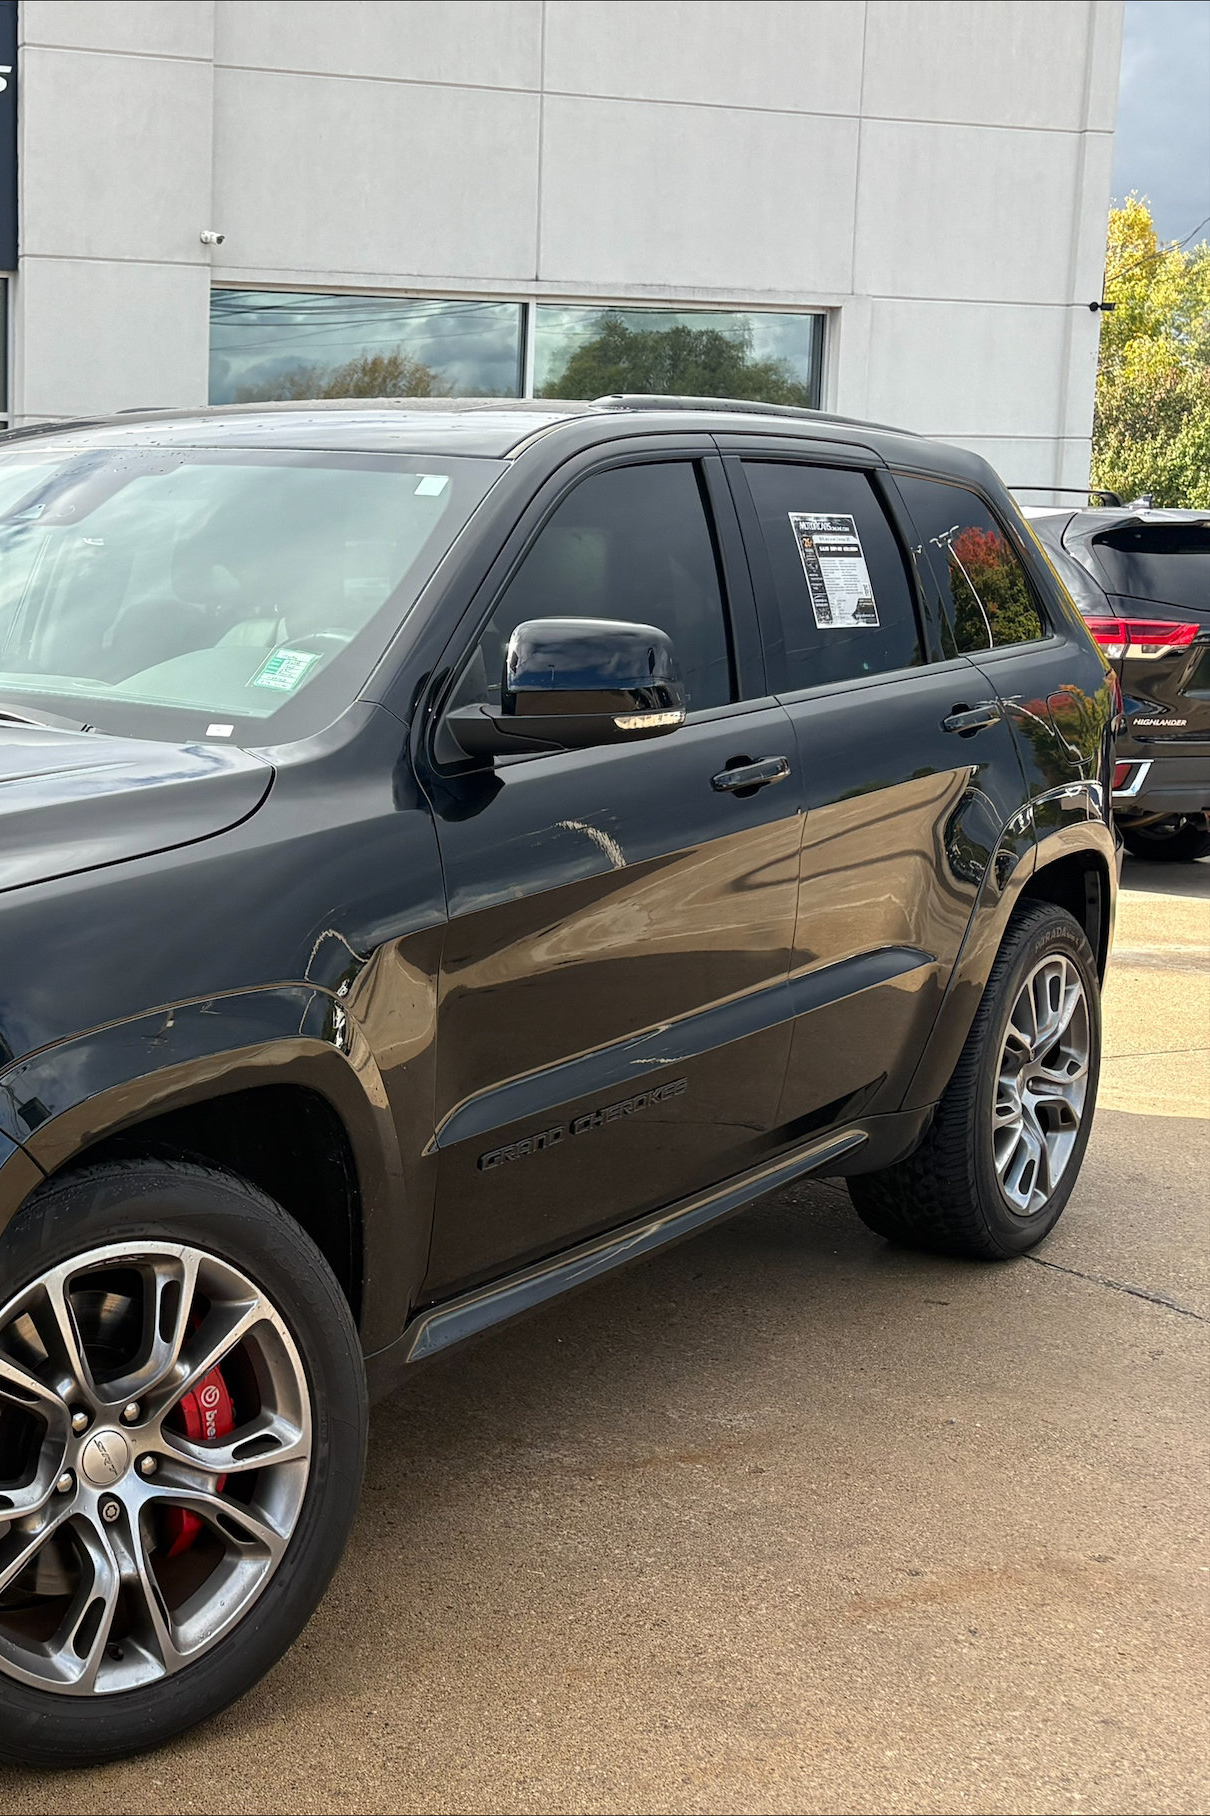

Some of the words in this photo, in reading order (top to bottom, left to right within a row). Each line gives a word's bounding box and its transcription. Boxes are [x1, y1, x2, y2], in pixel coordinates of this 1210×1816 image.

[1132, 718, 1188, 727] HIGHLANDER
[477, 1124, 566, 1171] GRAND
[569, 1076, 688, 1136] CHEROKEE
[205, 1409, 218, 1439] bre
[93, 1439, 118, 1476] SRT
